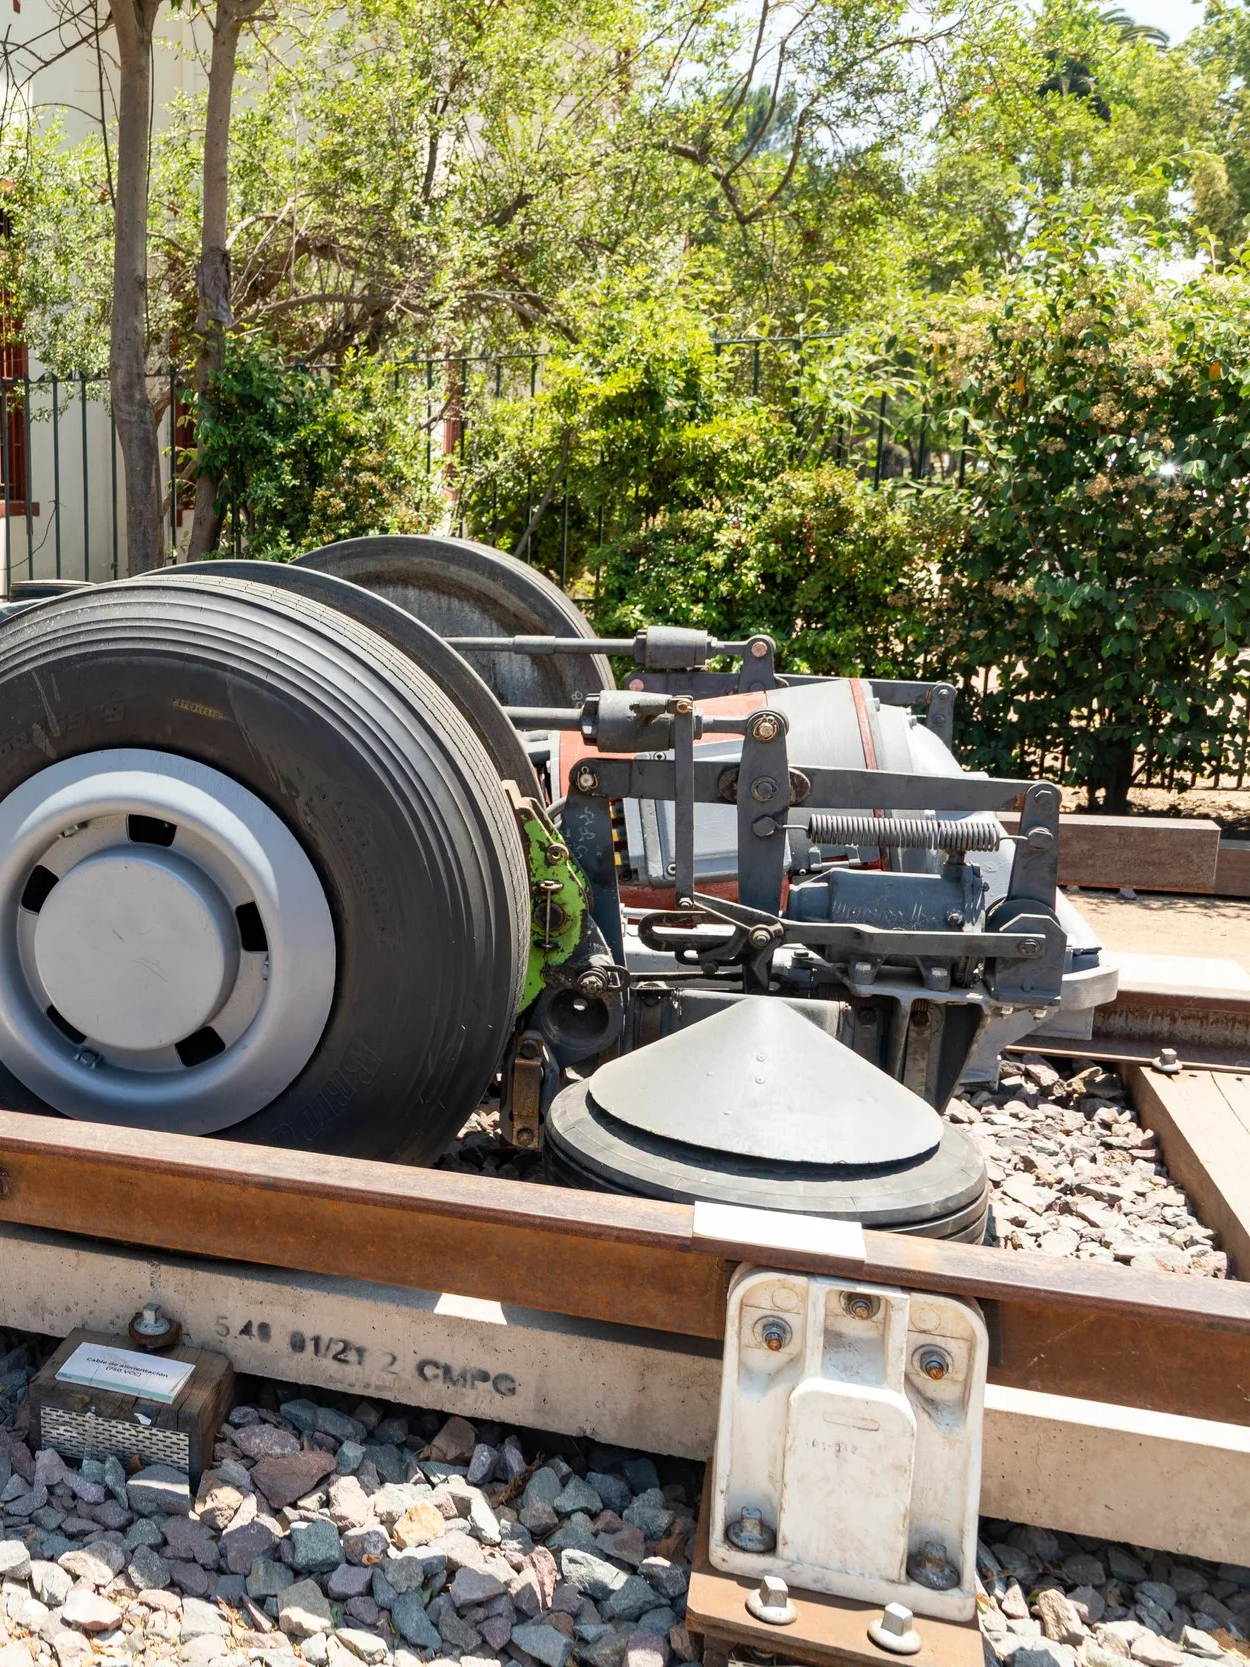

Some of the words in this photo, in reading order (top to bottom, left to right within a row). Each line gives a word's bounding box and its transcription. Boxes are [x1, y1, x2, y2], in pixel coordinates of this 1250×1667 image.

[86, 1356, 108, 1365] Cable
[119, 1363, 169, 1378] alimentación
[124, 1369, 142, 1377] VCC)
